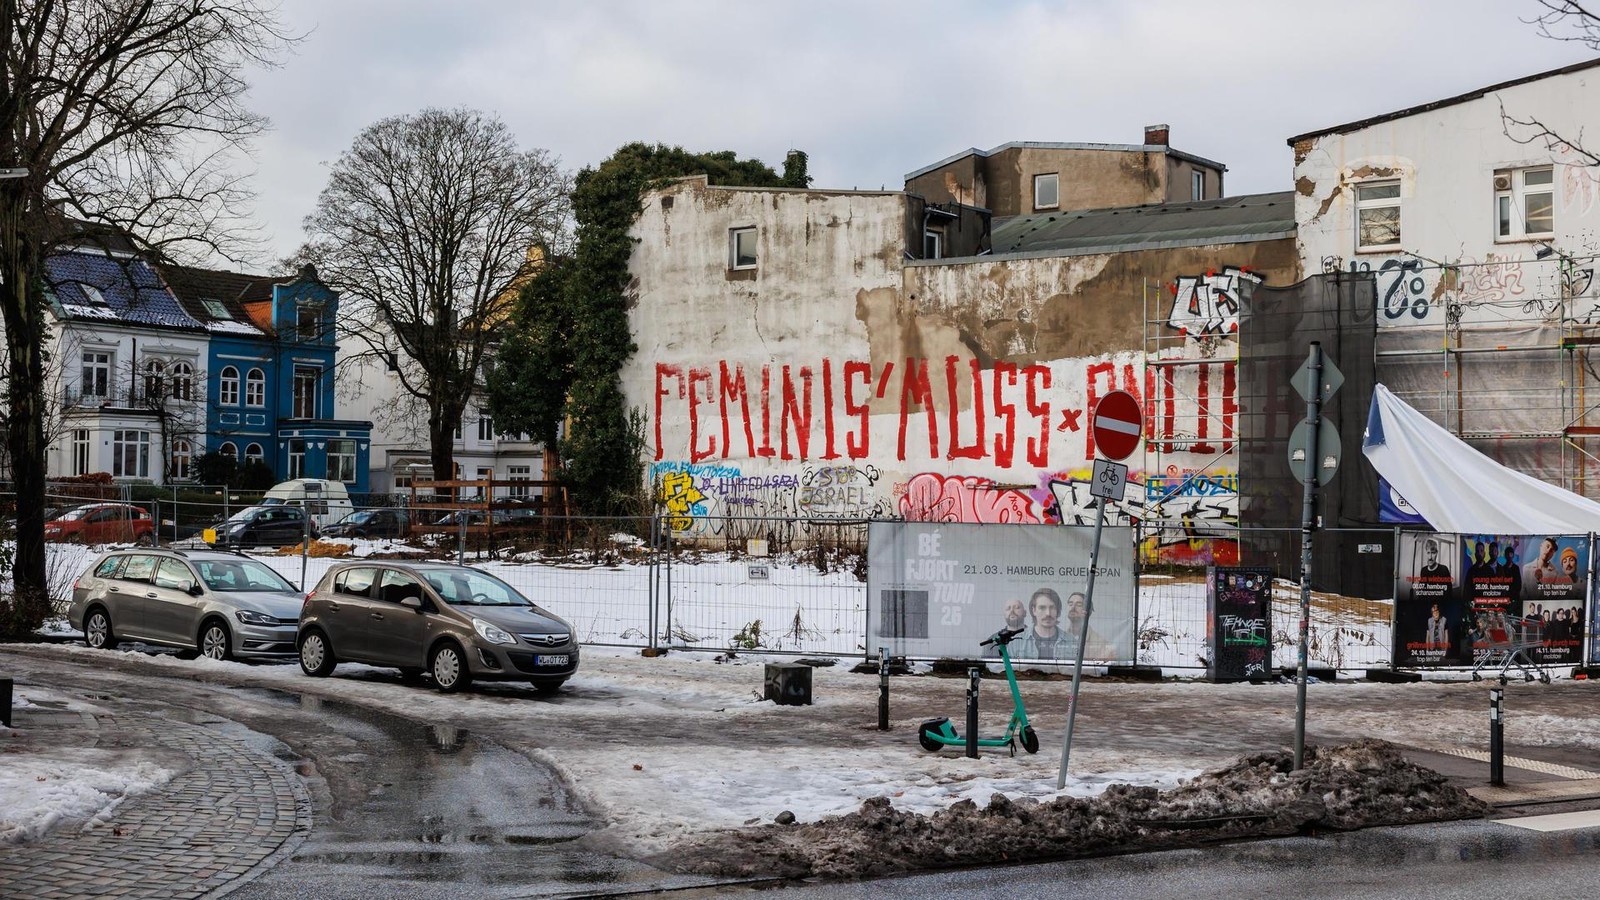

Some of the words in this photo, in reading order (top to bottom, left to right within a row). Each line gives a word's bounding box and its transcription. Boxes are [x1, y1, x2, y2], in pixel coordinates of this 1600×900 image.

[819, 466, 857, 487] STOP
[1102, 485, 1114, 495] frei
[918, 528, 942, 557] BÉ
[964, 564, 1003, 575] 21.03.
[1006, 566, 1055, 576] HAMBURG
[1059, 566, 1121, 577] GRUESPAN
[933, 582, 975, 604] TOUR
[1426, 583, 1448, 591] hamburg
[941, 605, 962, 626] 26
[1426, 649, 1446, 657] hamburg
